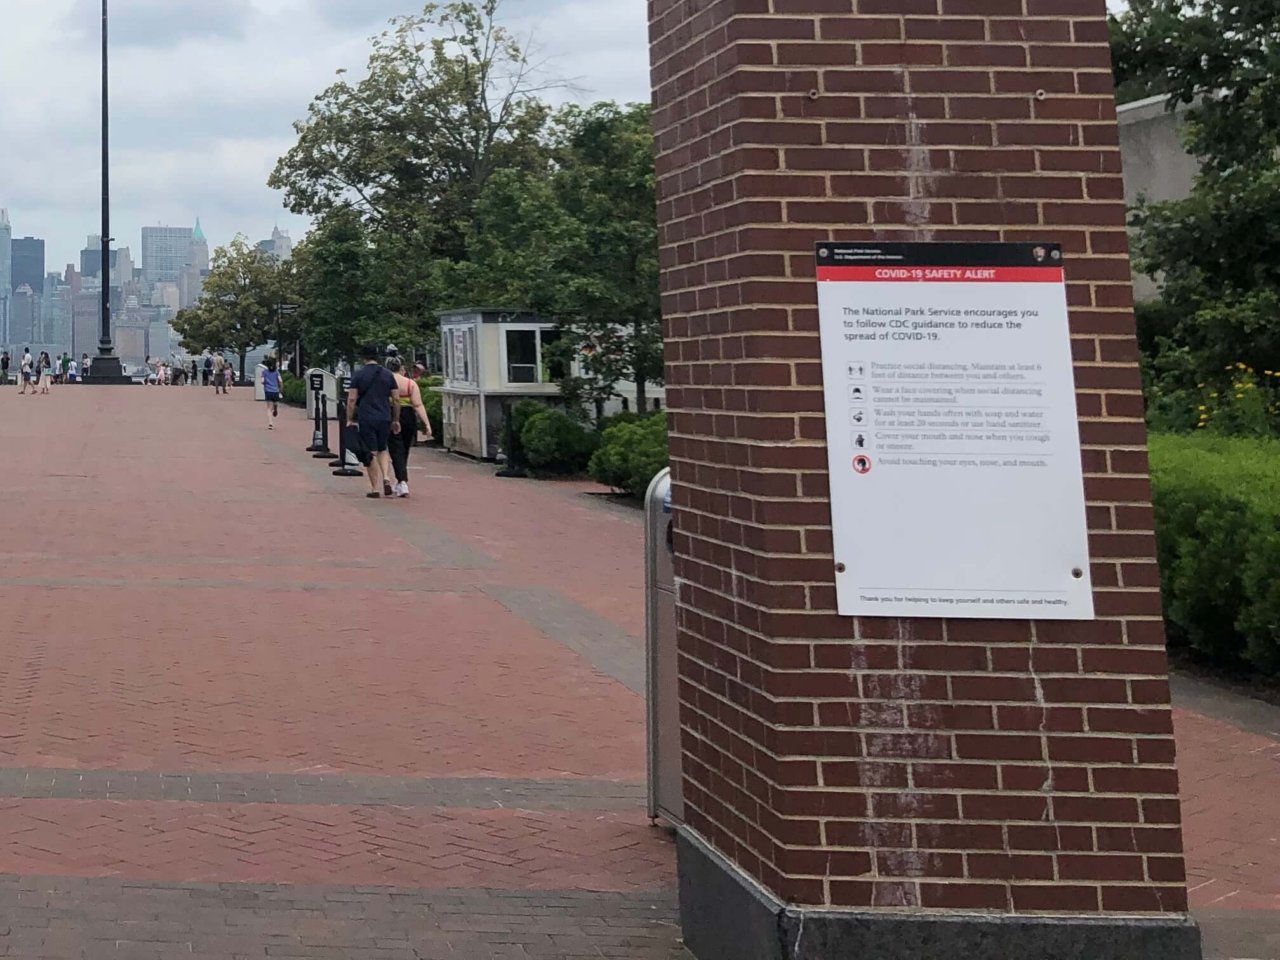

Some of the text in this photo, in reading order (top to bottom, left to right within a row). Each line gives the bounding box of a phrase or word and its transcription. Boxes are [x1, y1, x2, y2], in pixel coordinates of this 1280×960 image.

[875, 269, 996, 278] COVID-19 SAFETY ALERT
[842, 308, 1039, 318] The National Park Service encourages you
[843, 320, 853, 328] to
[856, 320, 886, 328] follow
[889, 320, 909, 328] CDC
[912, 320, 955, 330] guidance
[970, 320, 1003, 329] reduce
[1006, 320, 1022, 329] the
[844, 332, 940, 341] spread of COVID-19.
